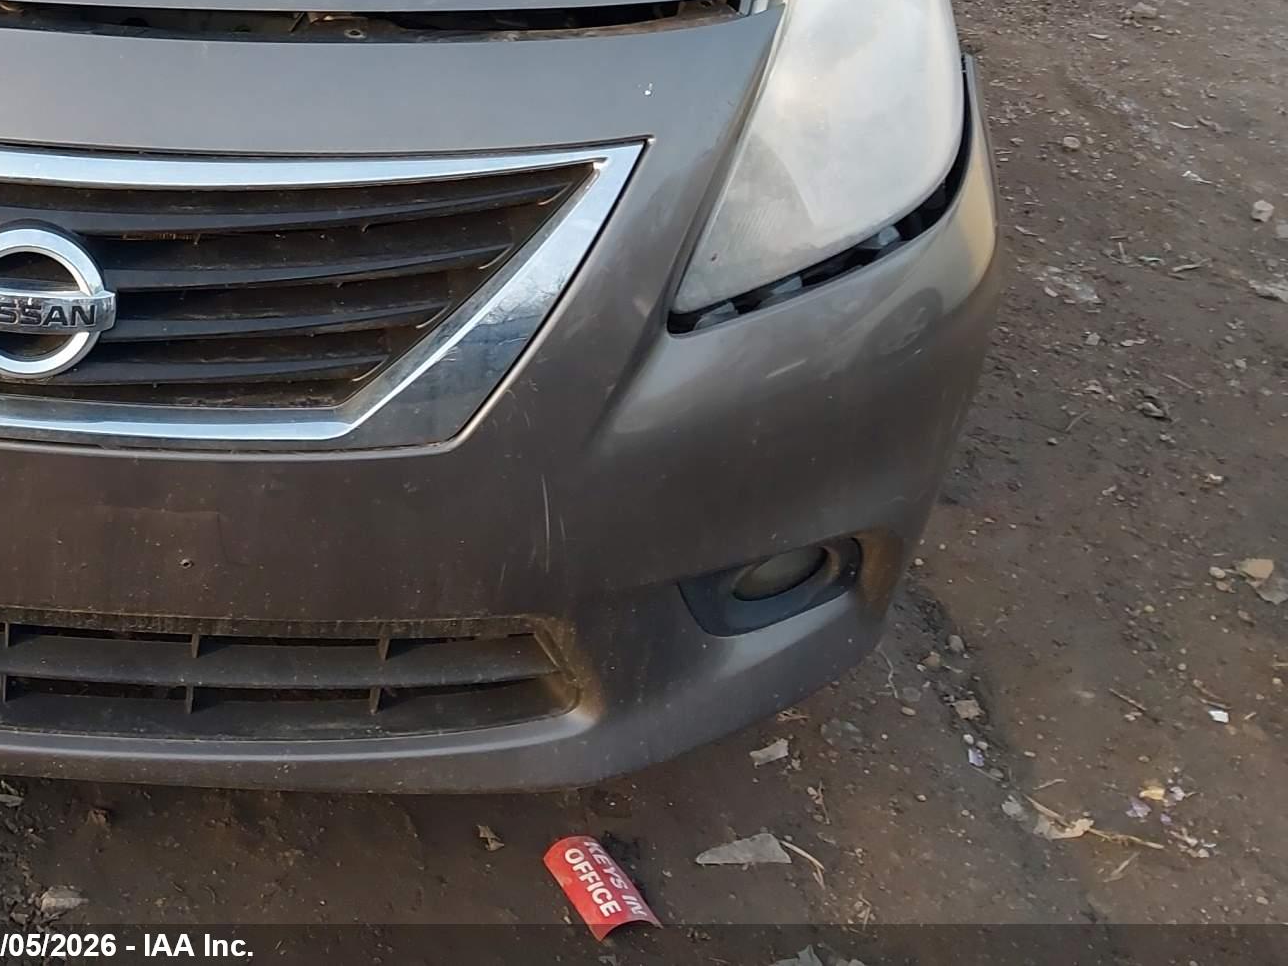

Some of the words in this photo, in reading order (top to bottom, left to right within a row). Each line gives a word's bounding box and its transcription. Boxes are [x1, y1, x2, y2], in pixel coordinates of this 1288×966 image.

[564, 847, 623, 918] OFFICE
[583, 840, 630, 890] KEYS
[621, 893, 649, 917] IN
